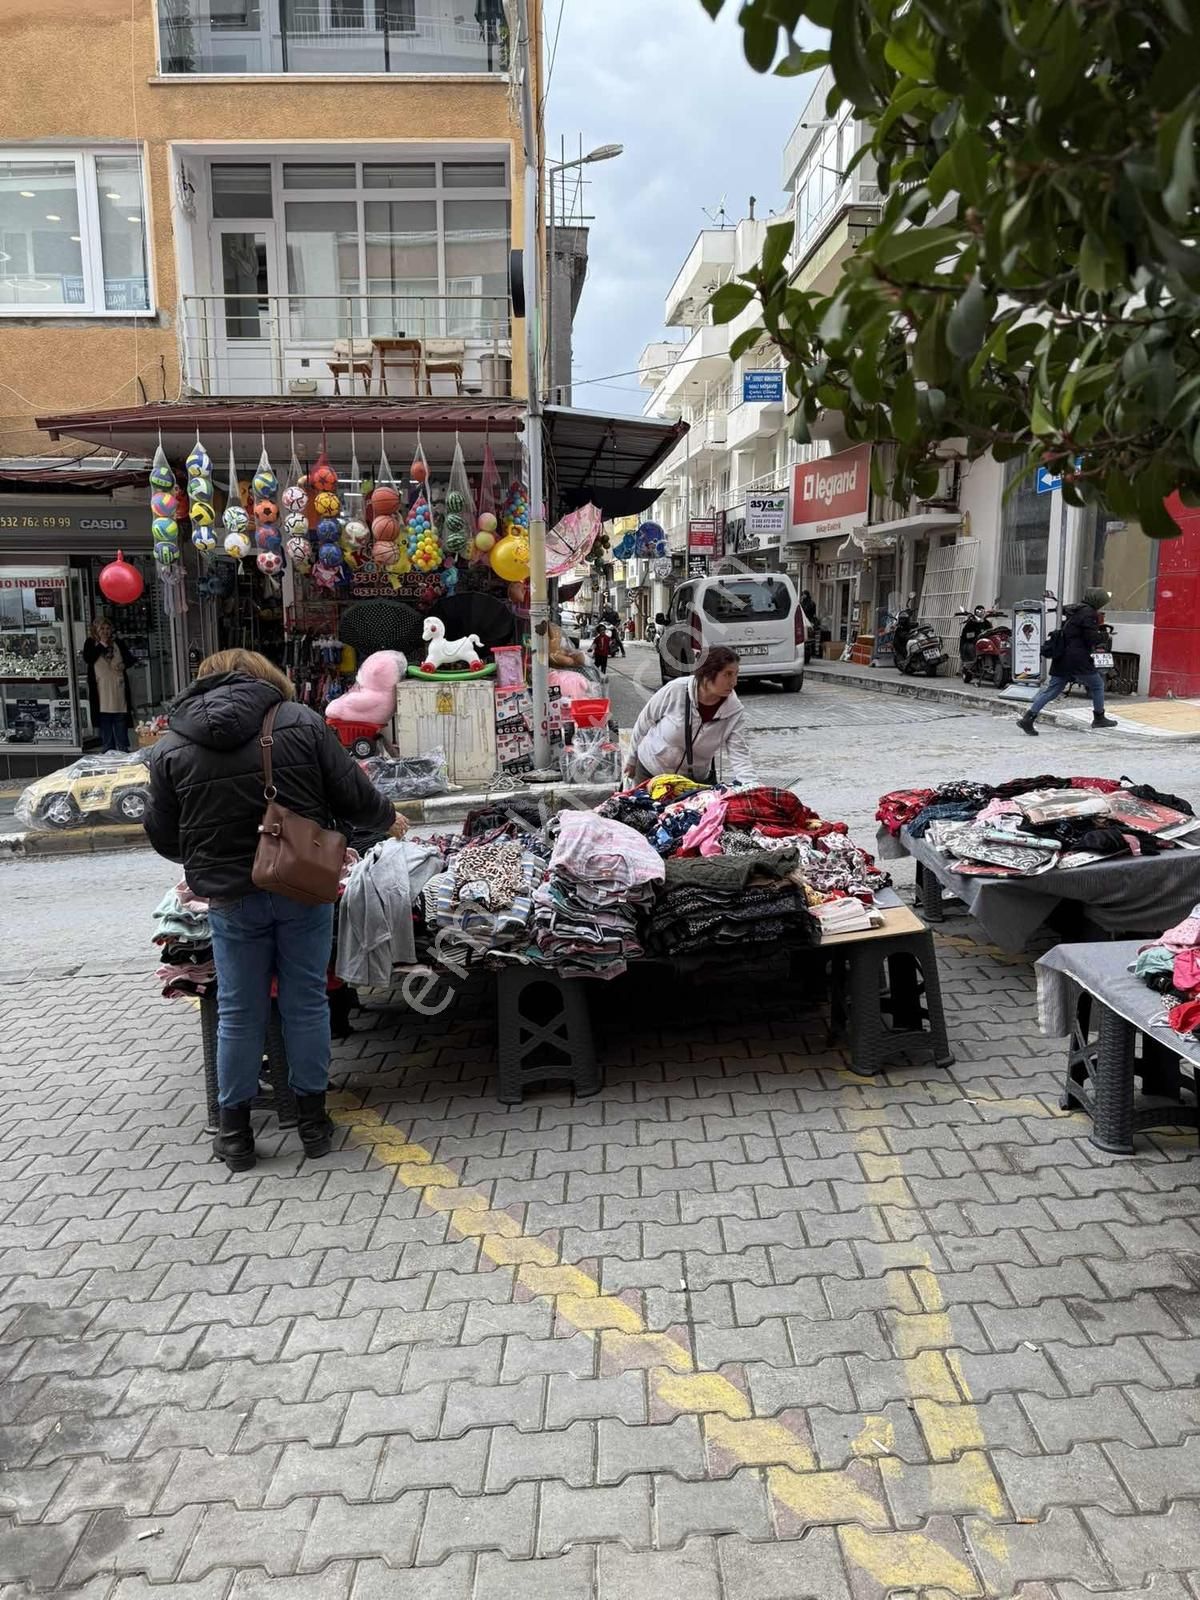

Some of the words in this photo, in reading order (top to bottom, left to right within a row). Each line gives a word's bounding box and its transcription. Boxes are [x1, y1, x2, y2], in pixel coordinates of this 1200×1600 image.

[815, 460, 858, 506] legrand
[750, 499, 774, 512] asya
[22, 516, 40, 528] 762
[43, 516, 56, 528] 69
[58, 516, 71, 528] 99
[80, 519, 126, 529] CASIO
